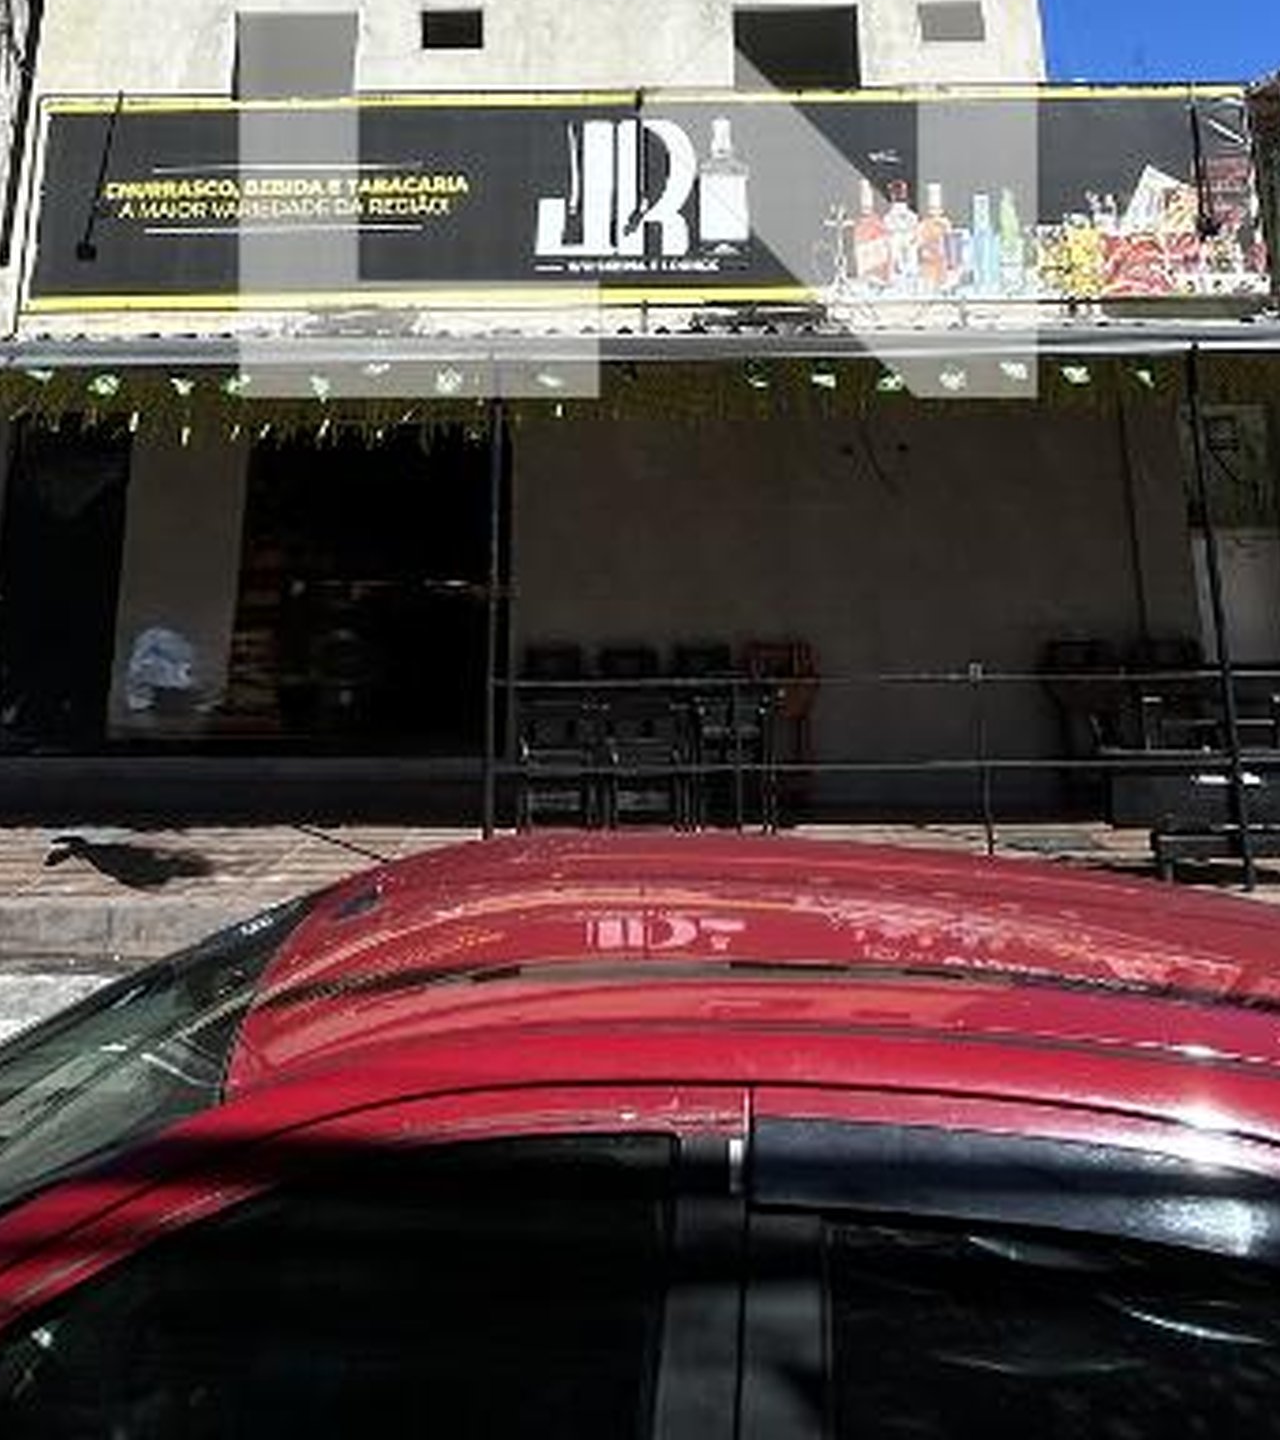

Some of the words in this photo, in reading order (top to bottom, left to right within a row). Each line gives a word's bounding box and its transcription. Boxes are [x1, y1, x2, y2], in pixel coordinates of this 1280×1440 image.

[244, 178, 325, 198] BEBIDA
[347, 174, 470, 197] TABACARIA
[140, 201, 208, 220] MAIOR
[211, 200, 330, 218] VARIEDADE
